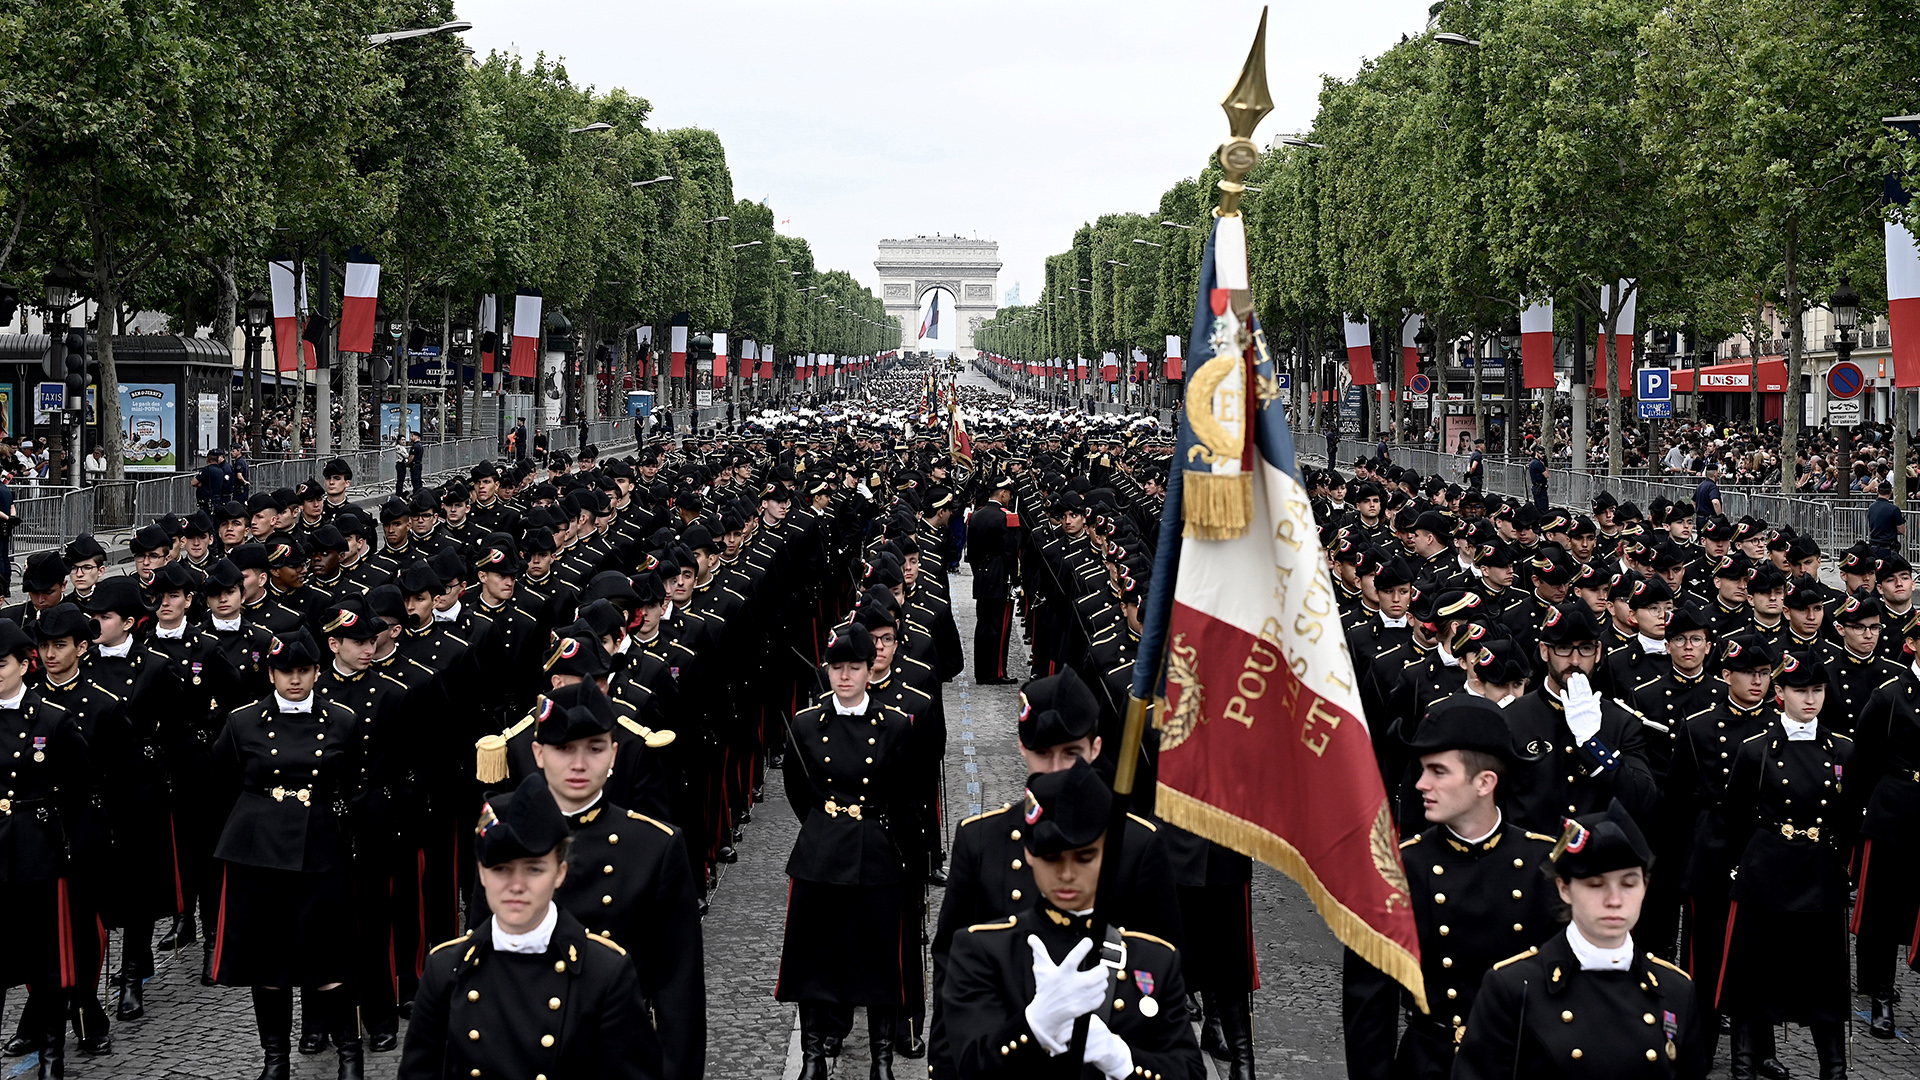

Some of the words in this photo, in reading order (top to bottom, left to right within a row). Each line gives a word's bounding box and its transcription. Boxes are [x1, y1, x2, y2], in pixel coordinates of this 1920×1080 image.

[1279, 377, 1286, 387] P
[1648, 374, 1662, 394] P
[41, 392, 62, 402] TAXIS
[1452, 418, 1476, 427] benefi
[1223, 616, 1284, 729] POUR
[1301, 696, 1342, 758] ET
